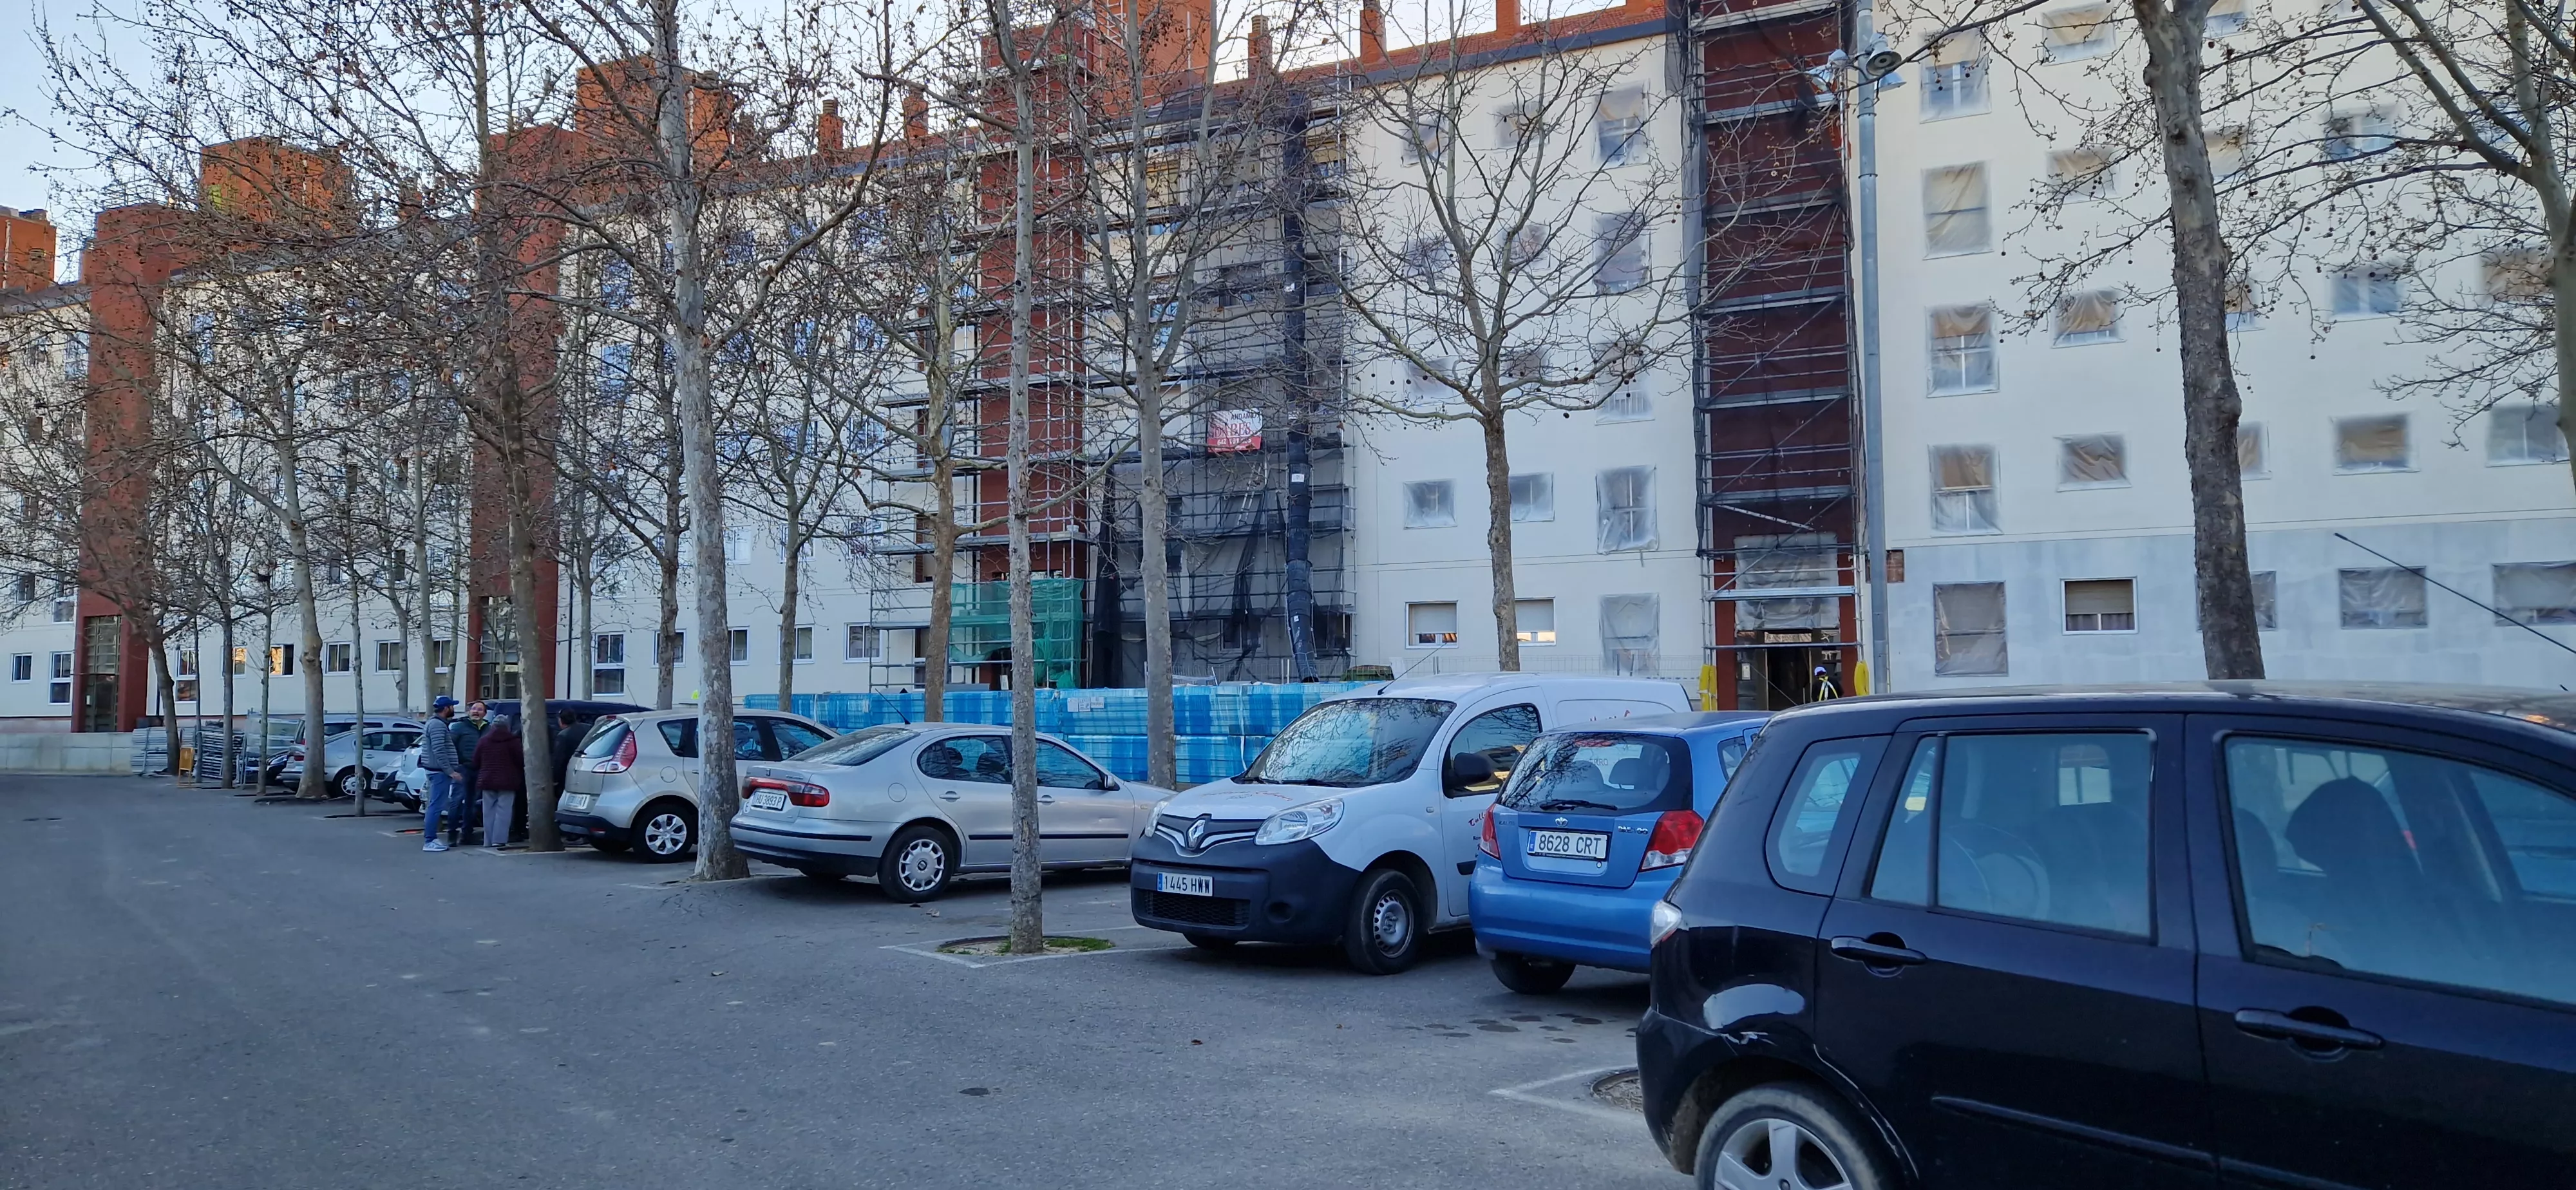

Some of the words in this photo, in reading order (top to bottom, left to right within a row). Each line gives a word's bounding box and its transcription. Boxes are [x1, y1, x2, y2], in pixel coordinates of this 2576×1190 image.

[776, 797, 782, 807] P
[1539, 834, 1570, 853] 8628
[1576, 836, 1602, 855] CRT
[1164, 875, 1188, 891] 1445
[1191, 876, 1210, 894] HWW
